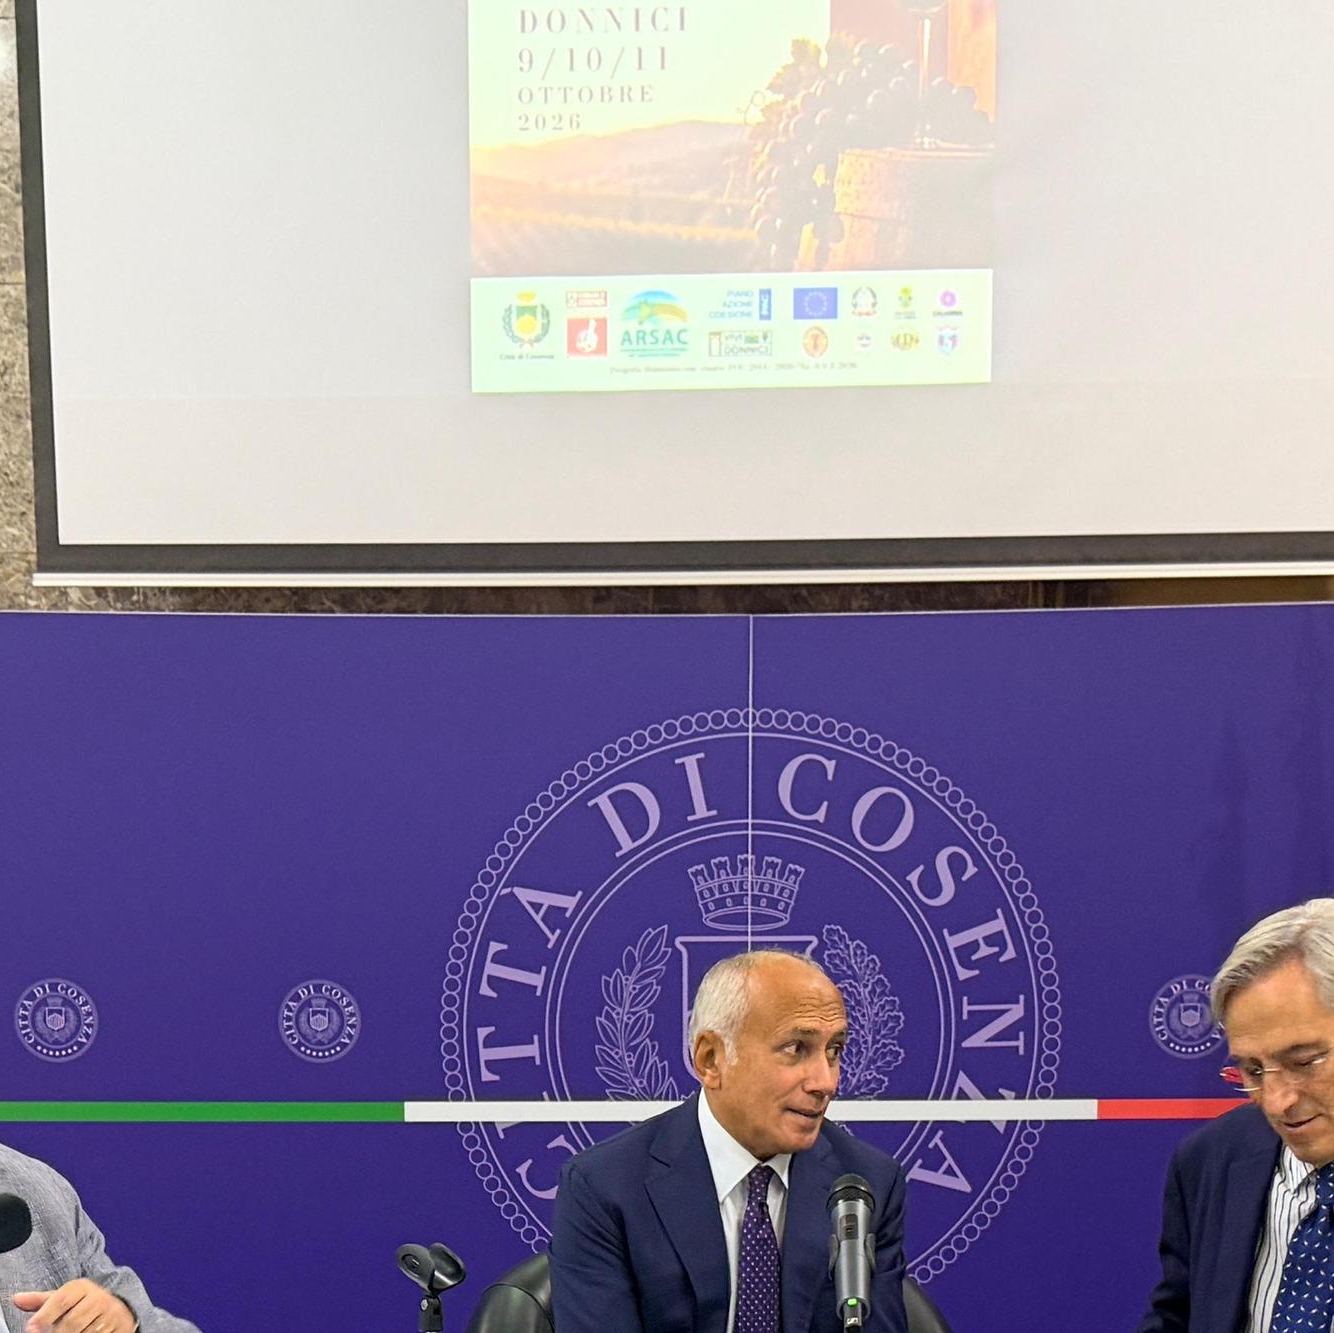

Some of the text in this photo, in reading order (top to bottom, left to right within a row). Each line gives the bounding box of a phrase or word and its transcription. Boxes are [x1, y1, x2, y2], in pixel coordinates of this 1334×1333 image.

[520, 7, 686, 34] DONNICI
[518, 46, 666, 81] 9/10/11
[518, 84, 654, 104] OTTOBRE
[518, 113, 581, 131] 2026
[621, 329, 689, 346] ARSAC
[588, 752, 719, 857] DI
[1170, 980, 1187, 994] DI
[33, 984, 50, 997] DI
[58, 983, 95, 1044] COSENZA
[298, 985, 314, 998] DI
[322, 985, 357, 1044] COSENZA
